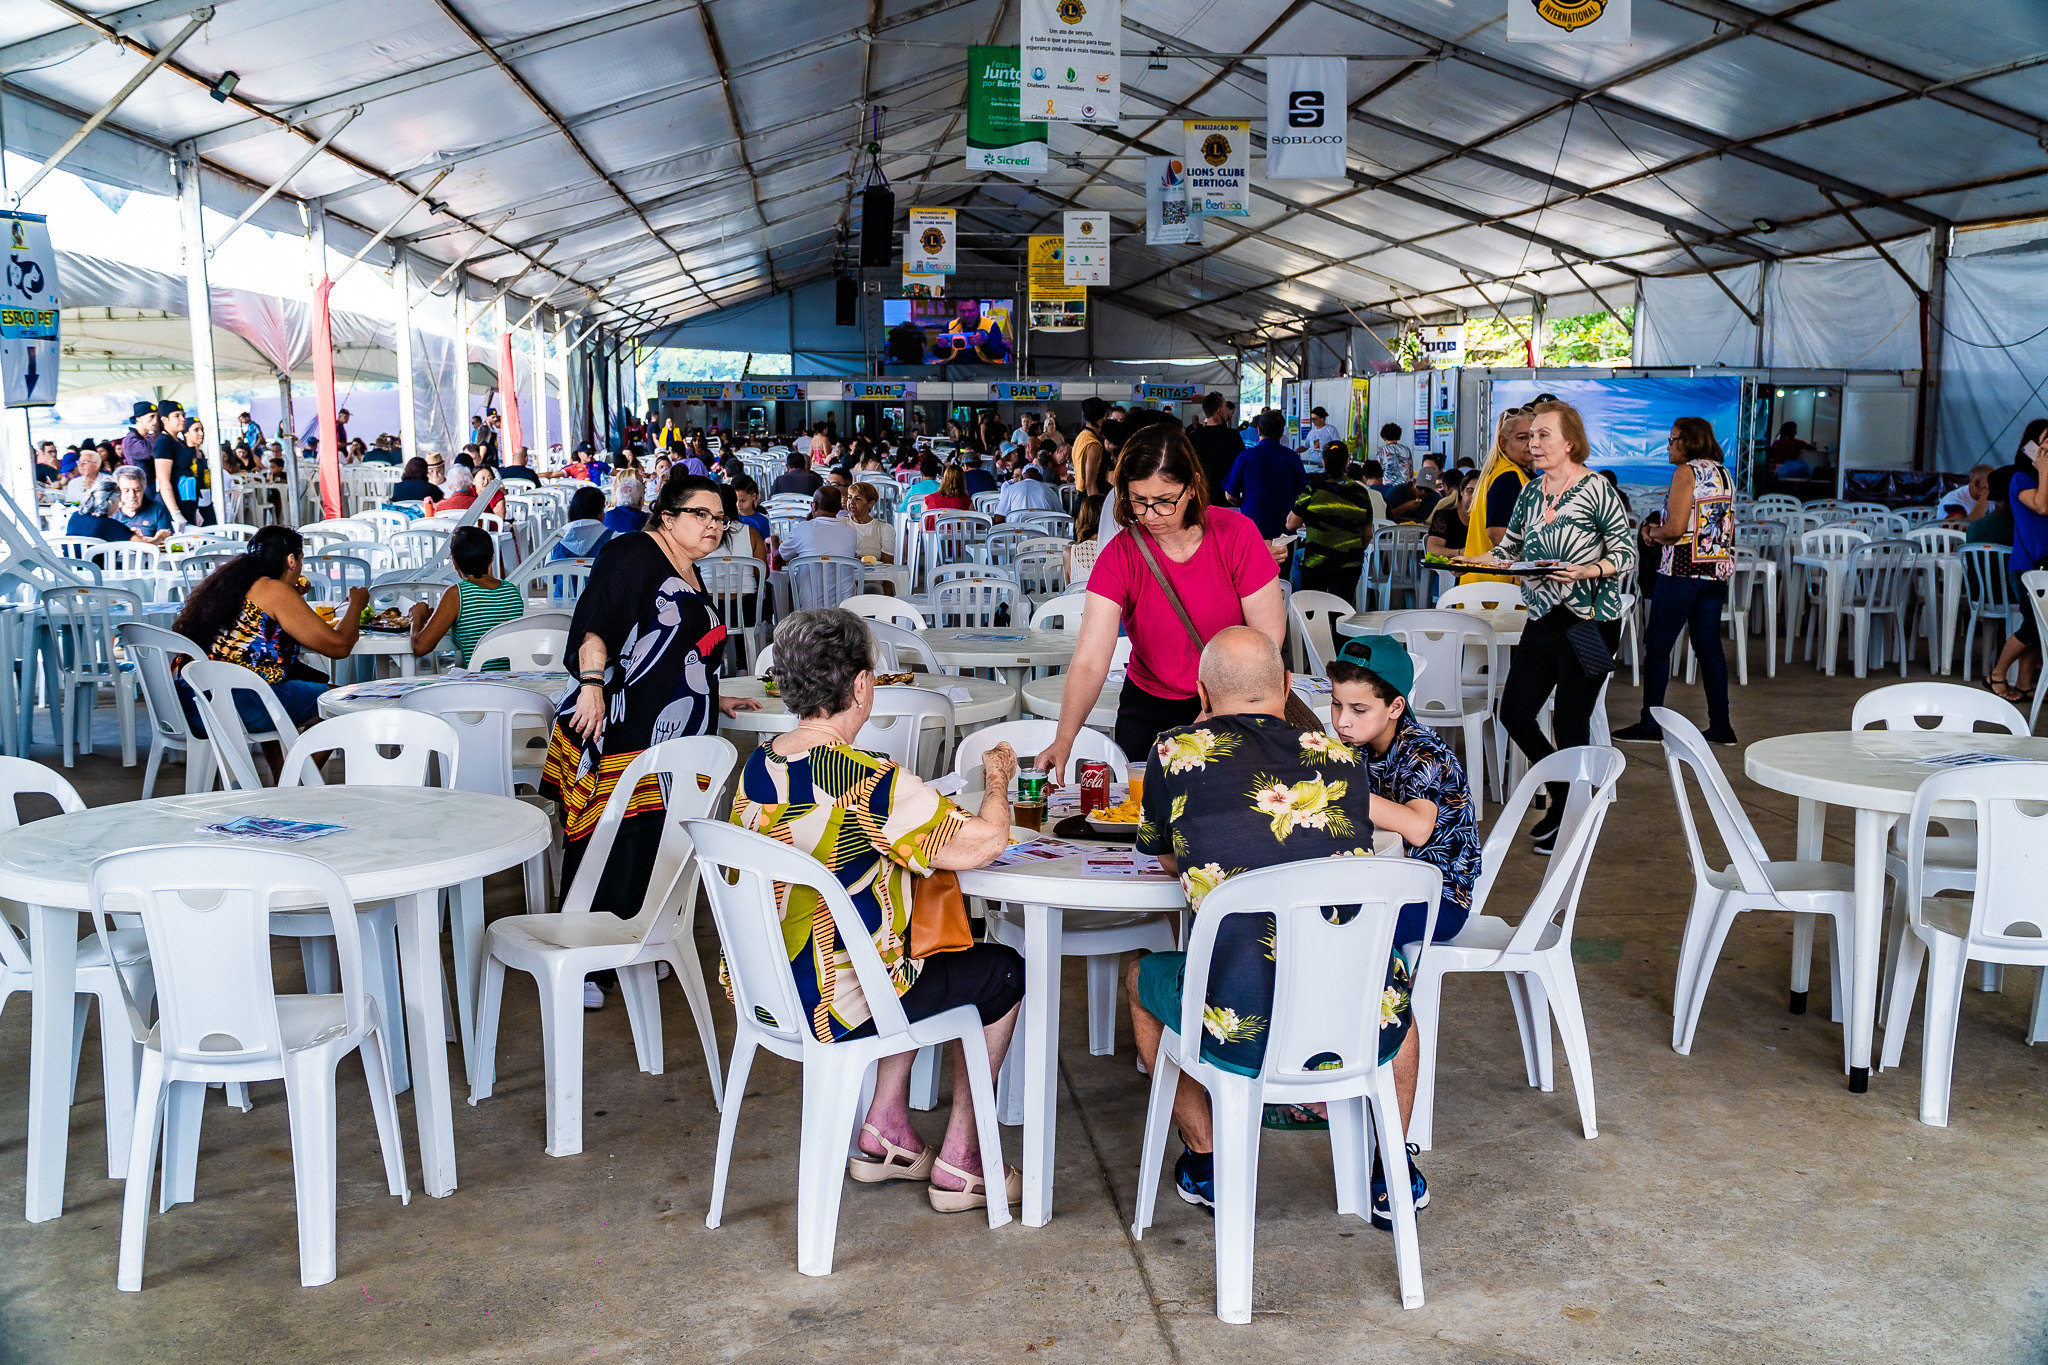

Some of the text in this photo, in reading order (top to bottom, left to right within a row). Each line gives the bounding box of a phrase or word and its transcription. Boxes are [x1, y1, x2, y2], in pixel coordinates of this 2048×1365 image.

[1542, 4, 1598, 23] INTERNATIONAL
[983, 65, 1021, 80] Junto
[997, 80, 1021, 88] Bertio
[1194, 123, 1228, 131] REALIZAÇÃO
[1271, 135, 1343, 145] SOBLOCO
[997, 155, 1030, 166] Sicredi
[1187, 168, 1245, 177] LIONS CLUBE
[1193, 179, 1239, 187] BERTIOGA
[1205, 199, 1242, 213] Bertioga
[1, 309, 55, 329] ESPAÇO PET
[671, 386, 720, 395] SORVETES
[751, 385, 789, 395] DOCES
[866, 385, 892, 395] BAR
[1010, 385, 1037, 396] BAR
[1149, 387, 1189, 398] FRITAS
